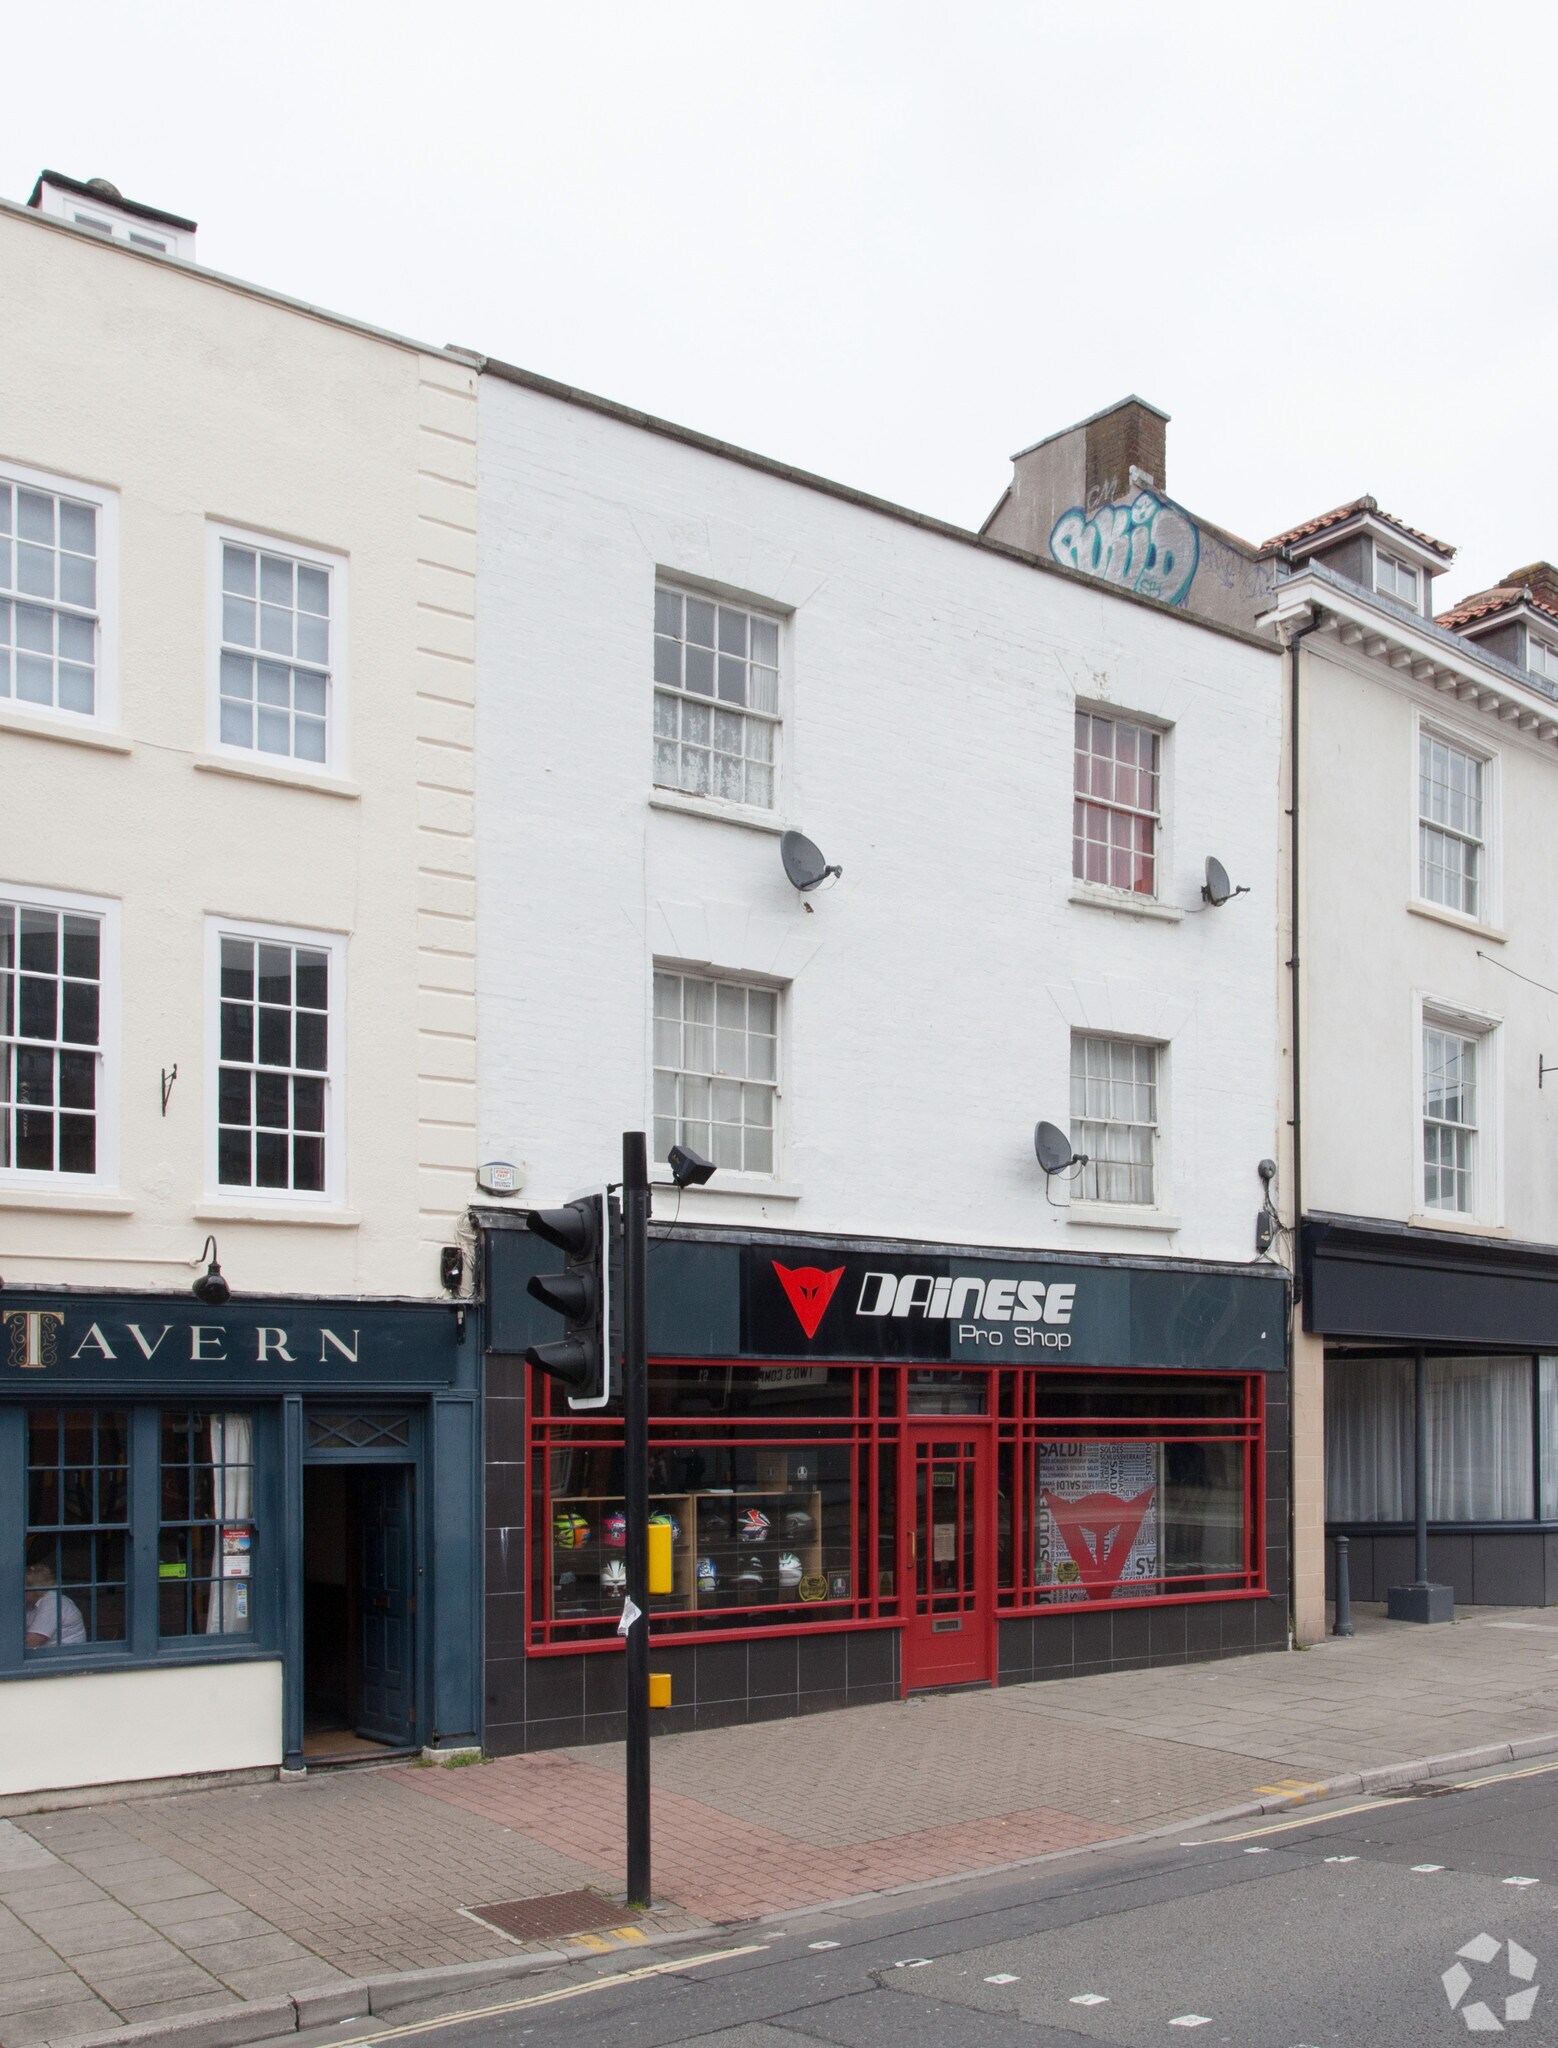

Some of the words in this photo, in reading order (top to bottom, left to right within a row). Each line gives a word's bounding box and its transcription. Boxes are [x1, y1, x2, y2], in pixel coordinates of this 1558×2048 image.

[3, 1310, 361, 1368] TAVERN
[958, 1324, 1003, 1346] Pro
[1014, 1326, 1072, 1350] Shop
[1040, 1442, 1082, 1457] SALDI
[1057, 1481, 1081, 1490] SALDI
